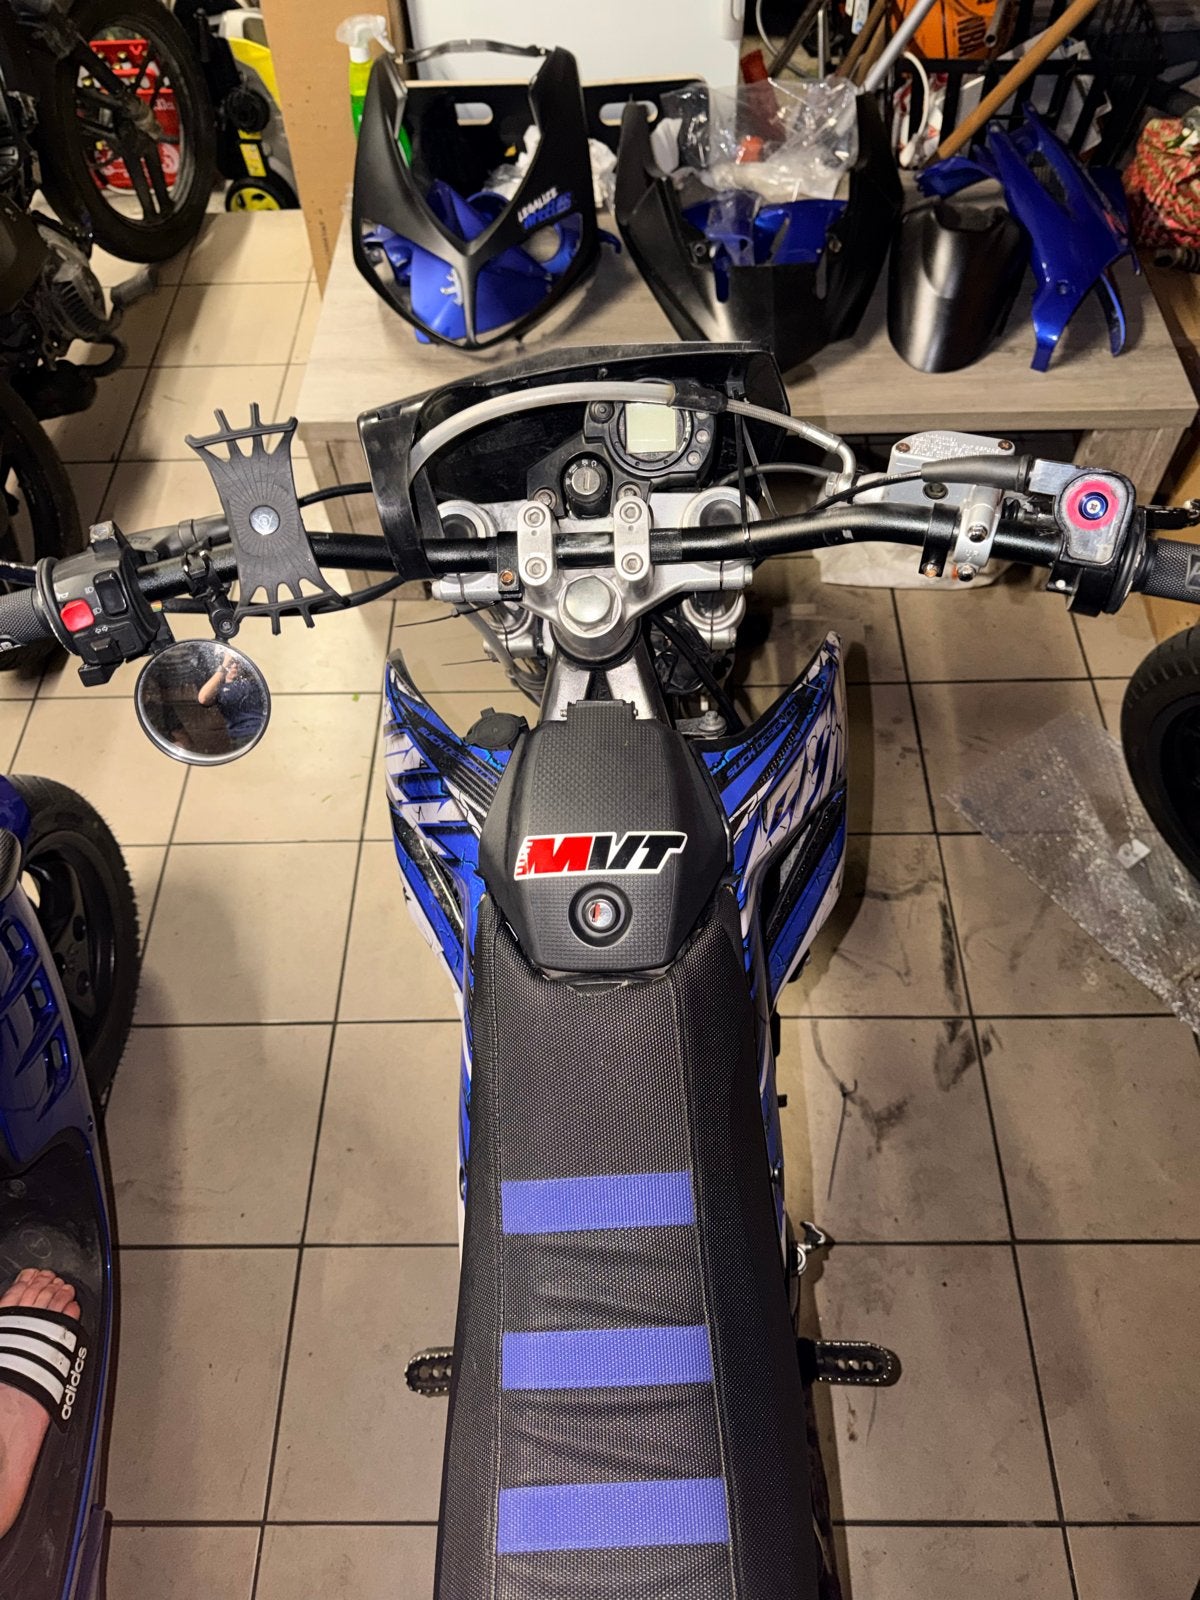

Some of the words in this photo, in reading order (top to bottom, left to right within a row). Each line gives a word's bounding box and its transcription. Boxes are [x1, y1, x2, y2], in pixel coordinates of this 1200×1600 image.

[957, 16, 986, 58] NBA
[726, 747, 756, 780] SLICK
[755, 716, 788, 752] DESIGN
[524, 833, 687, 876] MVT
[61, 1346, 87, 1420] adidas
